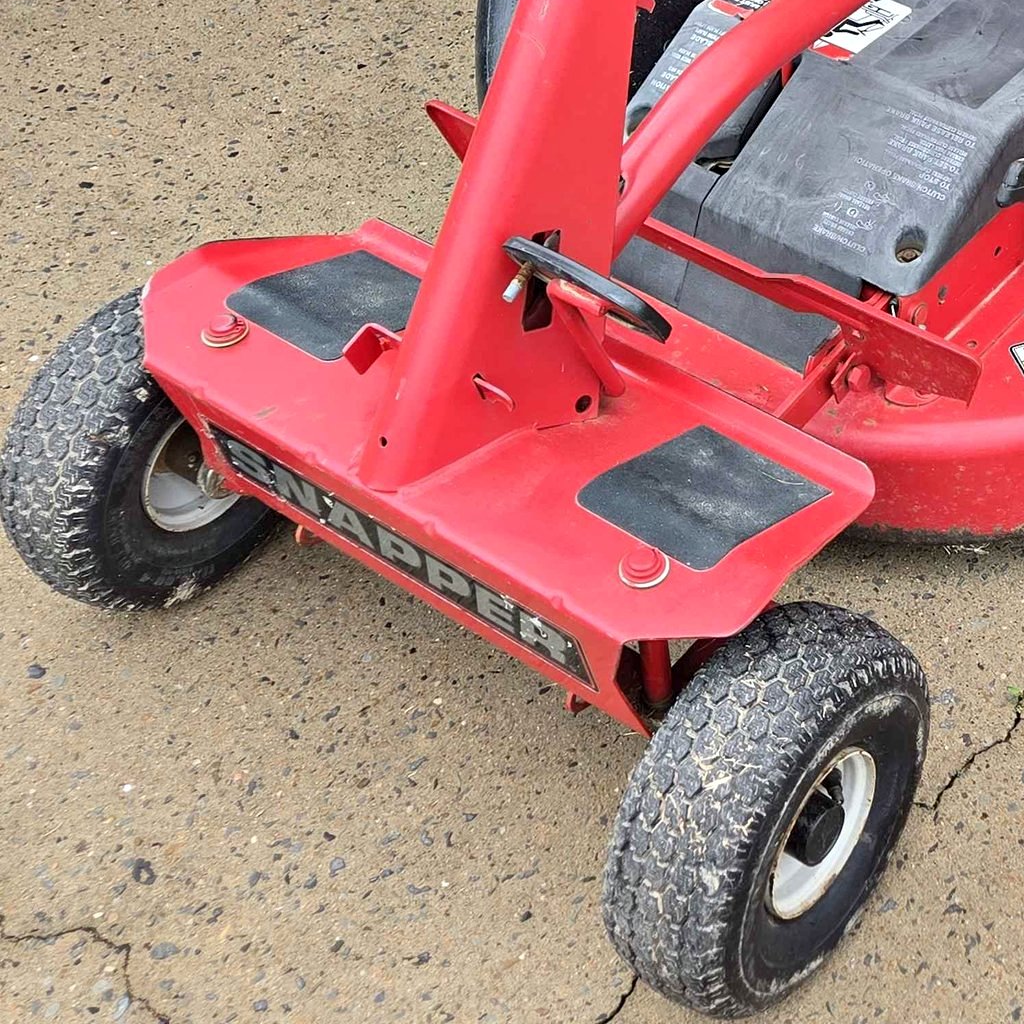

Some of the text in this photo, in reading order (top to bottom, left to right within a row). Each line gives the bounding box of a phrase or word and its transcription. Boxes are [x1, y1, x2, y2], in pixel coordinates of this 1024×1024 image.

[931, 125, 964, 144] RELEASE
[964, 140, 976, 150] TO
[812, 223, 866, 253] CLUTCH/BRAKE
[226, 439, 568, 666] SNAPPER
